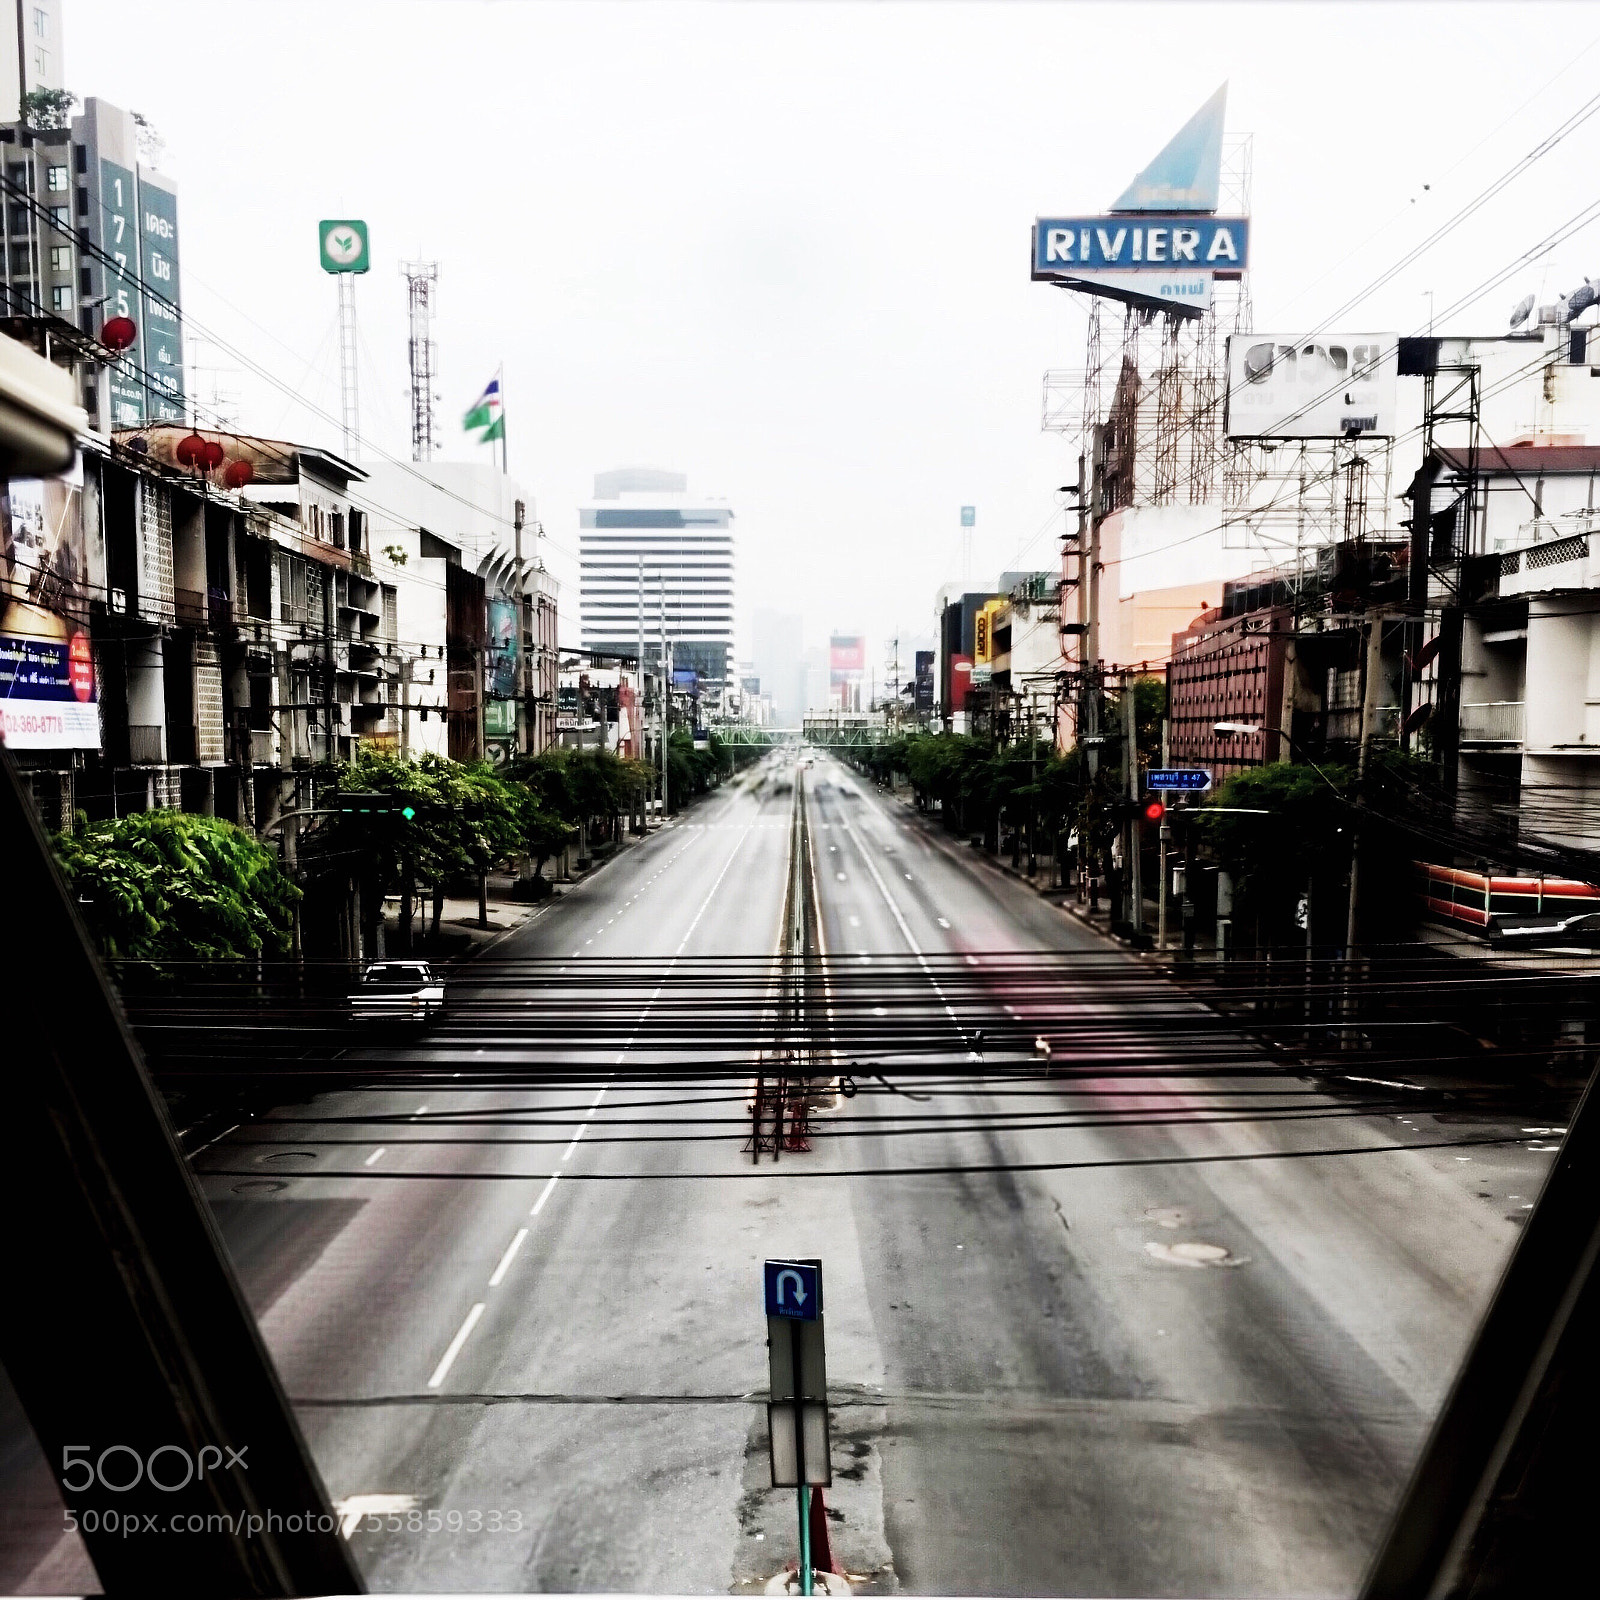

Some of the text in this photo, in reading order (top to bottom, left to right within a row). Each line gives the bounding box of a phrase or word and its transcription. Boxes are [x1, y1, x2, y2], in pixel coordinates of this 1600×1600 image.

[145, 212, 174, 239] เดอะ
[1046, 227, 1239, 263] RIVIERA
[1191, 773, 1201, 781] 47
